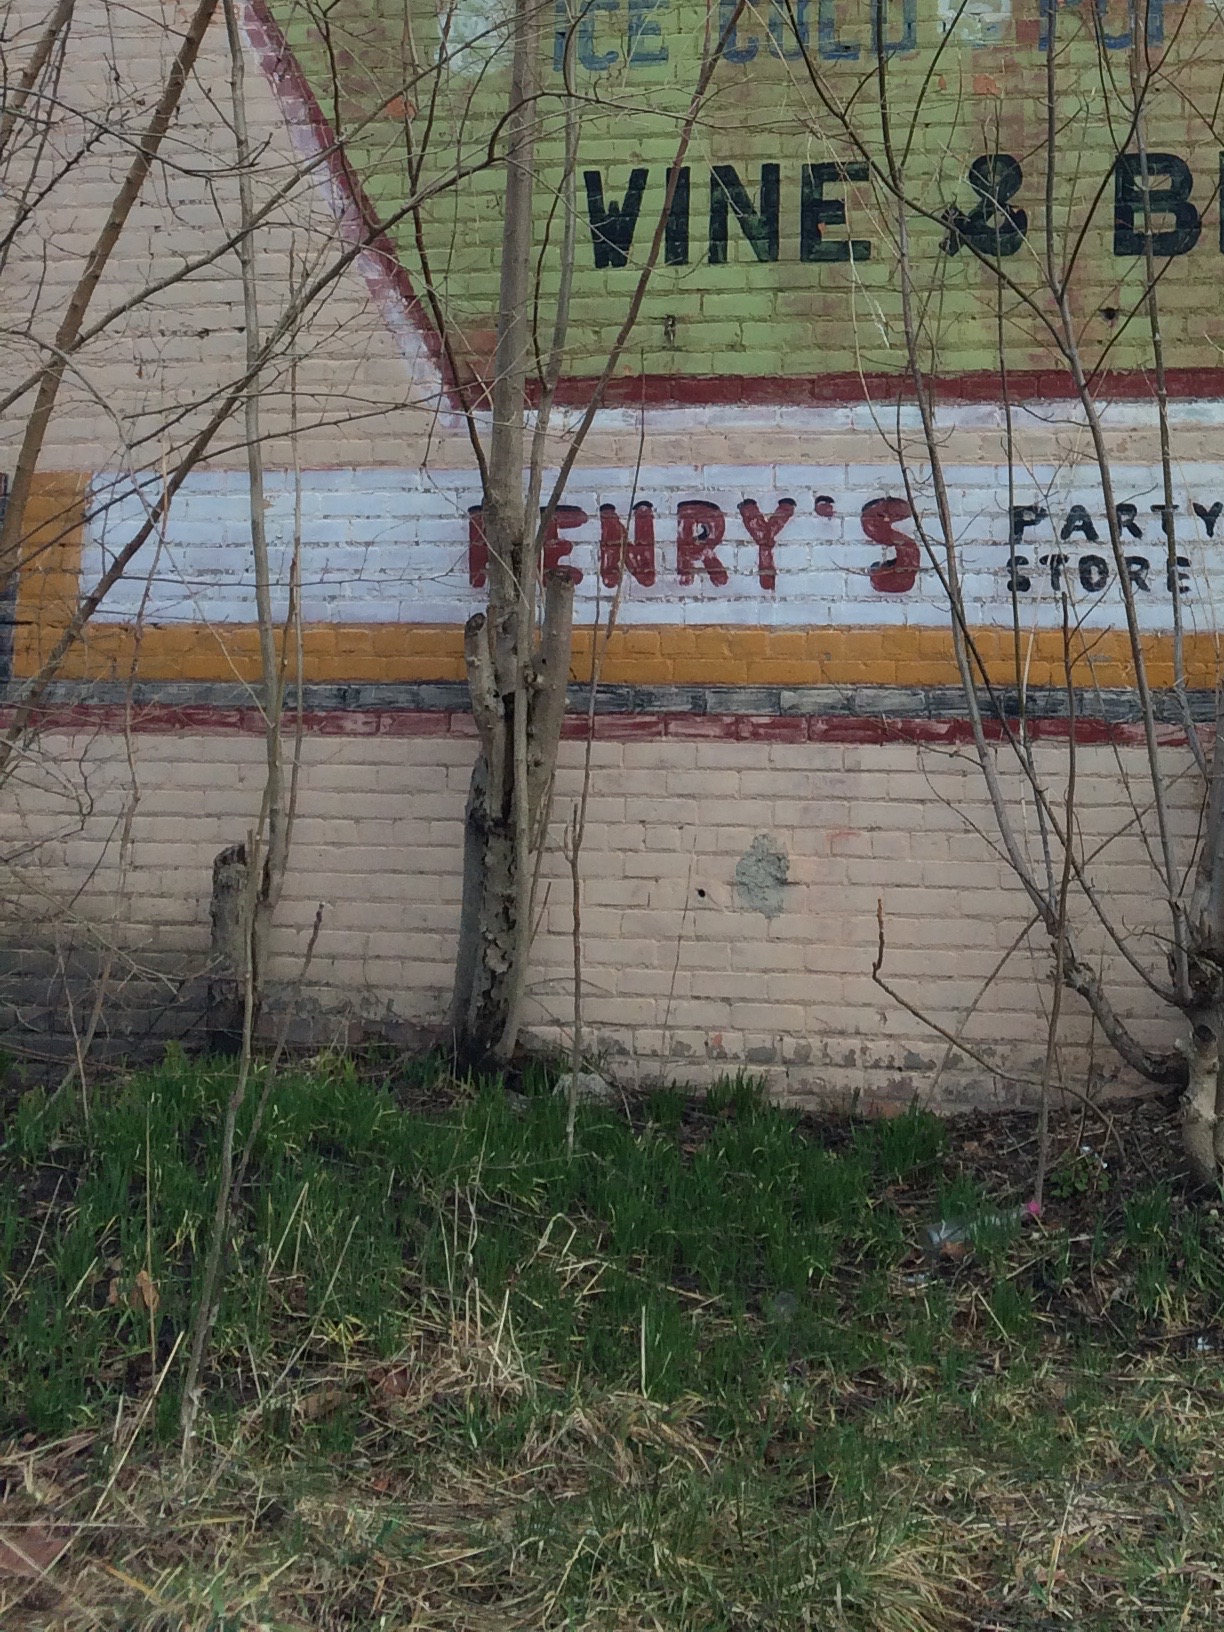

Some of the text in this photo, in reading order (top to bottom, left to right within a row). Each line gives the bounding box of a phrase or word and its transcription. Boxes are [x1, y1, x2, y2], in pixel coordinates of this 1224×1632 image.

[584, 162, 872, 270] WINE
[939, 153, 1028, 257] &
[1010, 500, 1224, 545] PARTY
[1006, 553, 1192, 593] STORE
